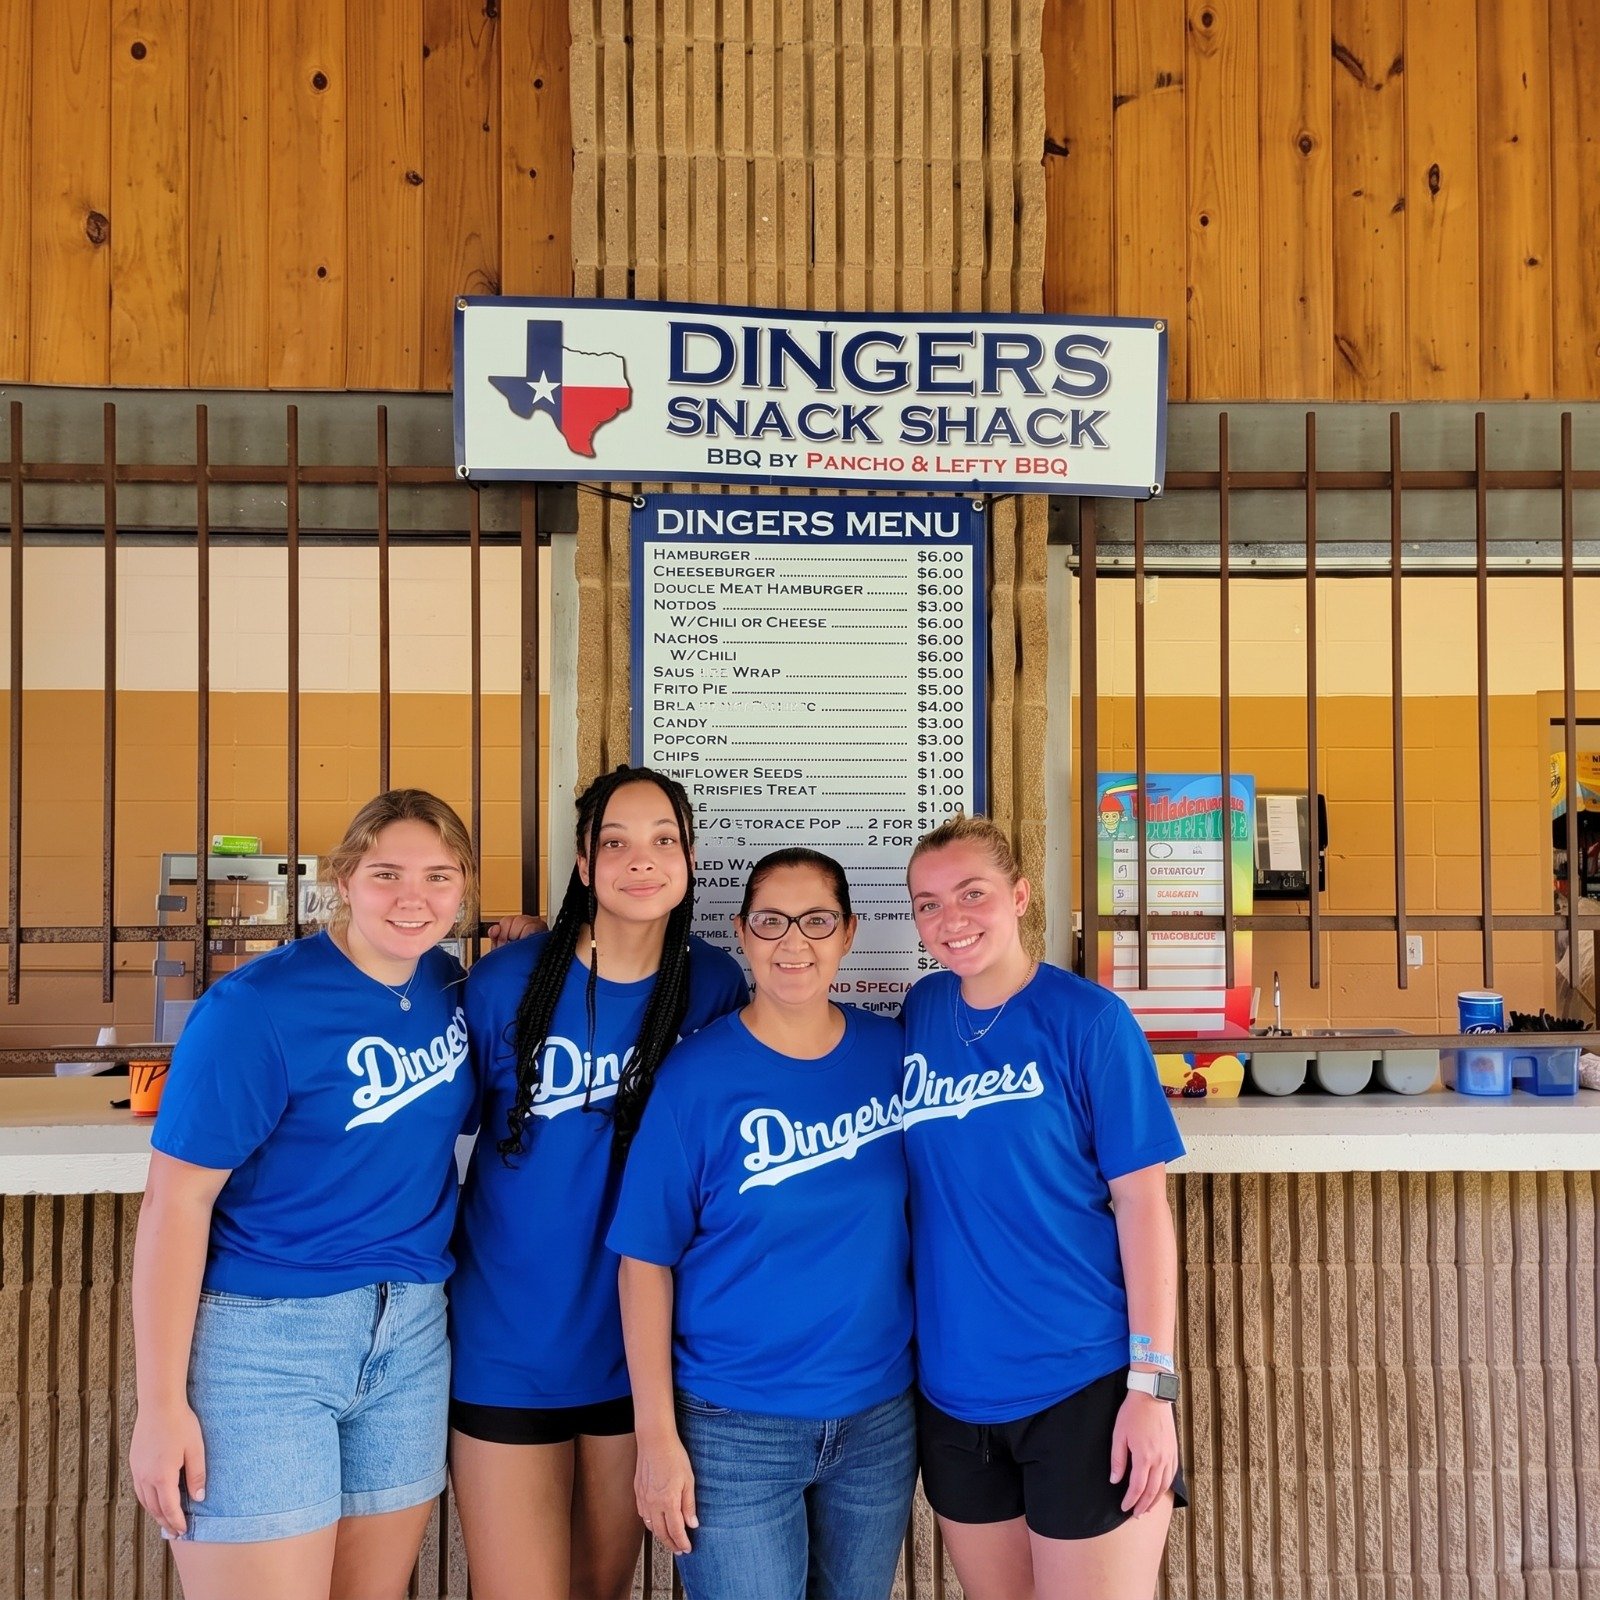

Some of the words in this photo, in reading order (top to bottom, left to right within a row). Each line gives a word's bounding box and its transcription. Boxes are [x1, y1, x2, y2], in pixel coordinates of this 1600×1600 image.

[668, 320, 1111, 398] DINGERS
[667, 397, 881, 443] SNACK
[900, 405, 1109, 448] SHACK
[706, 448, 761, 469] BBQ
[769, 452, 798, 468] BY
[806, 452, 905, 473] PANCHO
[911, 455, 928, 472] &
[935, 456, 1007, 474] LEFTY
[1014, 456, 1068, 477] BBQ
[657, 509, 834, 536] DINGERS
[847, 512, 959, 537] MENU
[654, 549, 750, 560] HAMBURGER
[918, 551, 963, 563] $6.00
[654, 566, 775, 577] CHEESEBURGER
[918, 567, 963, 579] $6.00
[721, 583, 762, 594] MEAT
[768, 583, 863, 594] HAMBURGER
[918, 584, 963, 595] $6.00
[654, 599, 716, 610] NOTDOS
[918, 601, 963, 612] $3.00
[670, 616, 736, 627] W/CHILI
[742, 618, 762, 627] OR
[767, 617, 826, 628] CHEESE
[918, 617, 963, 629] $6.00
[654, 633, 718, 644] NACHOS
[918, 634, 963, 645] $6.00
[670, 650, 736, 660] W/CHILI
[918, 651, 963, 663] $6.00
[733, 667, 780, 677] WRAP
[918, 667, 963, 679] $5.00
[654, 683, 698, 694] FRITO
[703, 684, 727, 694] PIE
[918, 684, 963, 695] $5.00
[918, 701, 963, 713] $4.00
[654, 717, 707, 728] CANDY
[918, 717, 963, 729] $3.00
[654, 734, 727, 744] POPCORN
[918, 734, 963, 746] $3.00
[654, 750, 699, 761] CHIPS
[918, 751, 963, 762] $1.00
[754, 767, 802, 778] SEEDS
[918, 767, 963, 779] $1.00
[767, 784, 817, 795] TREAT
[918, 784, 963, 796] $1.00
[918, 801, 964, 813] $1.00
[810, 818, 841, 829] POP
[868, 818, 878, 829] 2
[884, 820, 912, 829] FOR
[868, 835, 878, 845] 2
[883, 836, 912, 846] FOR
[700, 912, 726, 922] DIET
[903, 1053, 1043, 1110] Dingers
[740, 1094, 903, 1173] Dingers
